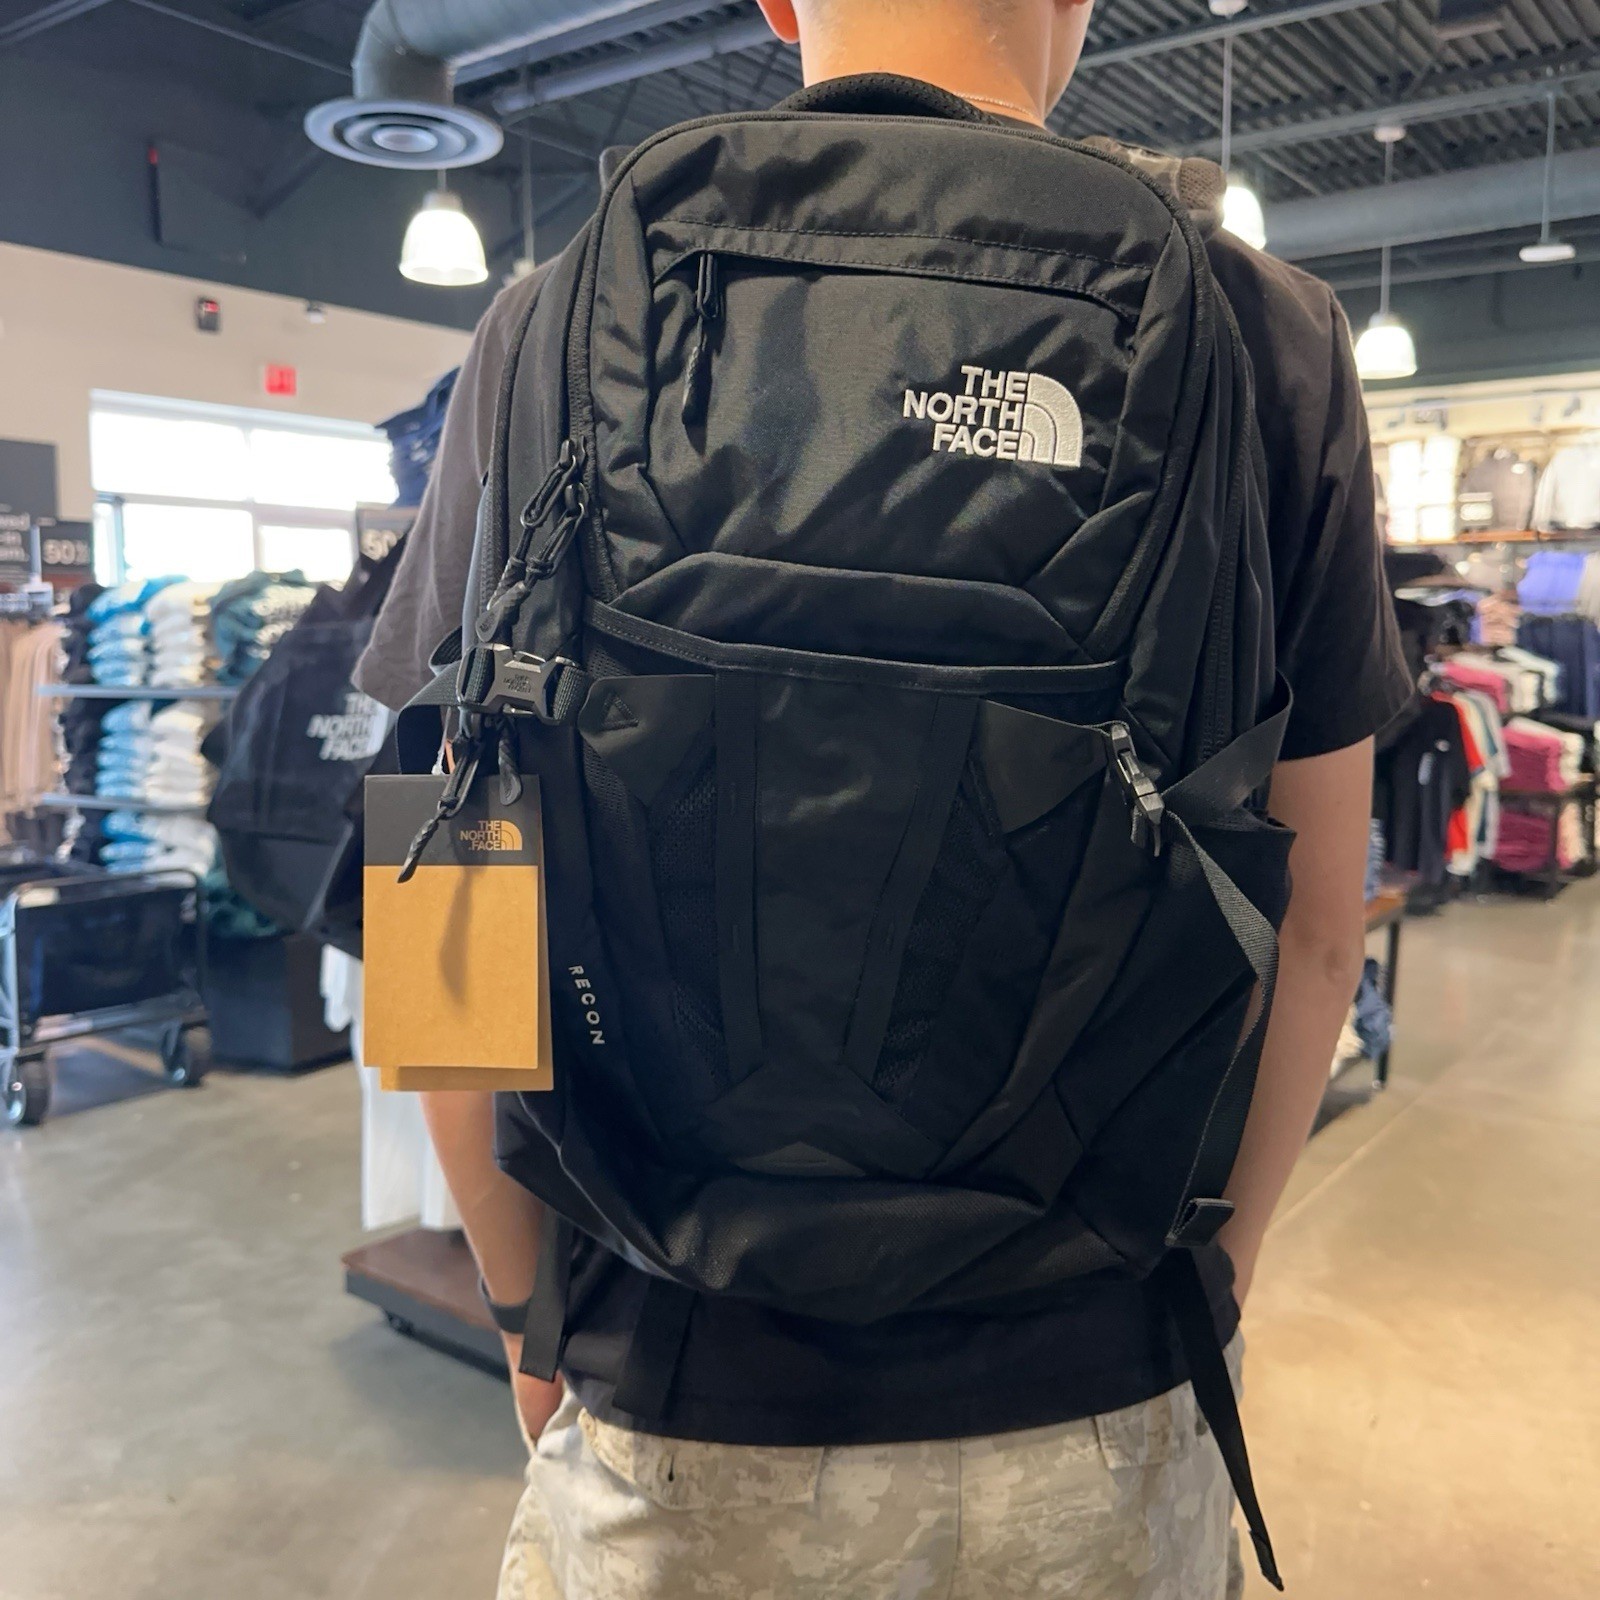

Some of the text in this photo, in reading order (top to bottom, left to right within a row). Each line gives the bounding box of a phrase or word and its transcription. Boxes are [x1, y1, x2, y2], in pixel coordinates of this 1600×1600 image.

[961, 365, 1029, 402] THE
[903, 389, 1023, 430] NORTH
[932, 423, 1020, 460] FACE
[460, 830, 501, 841] NORTH
[478, 820, 501, 831] THE
[471, 840, 501, 851] FACE
[568, 965, 605, 1044] RECON
